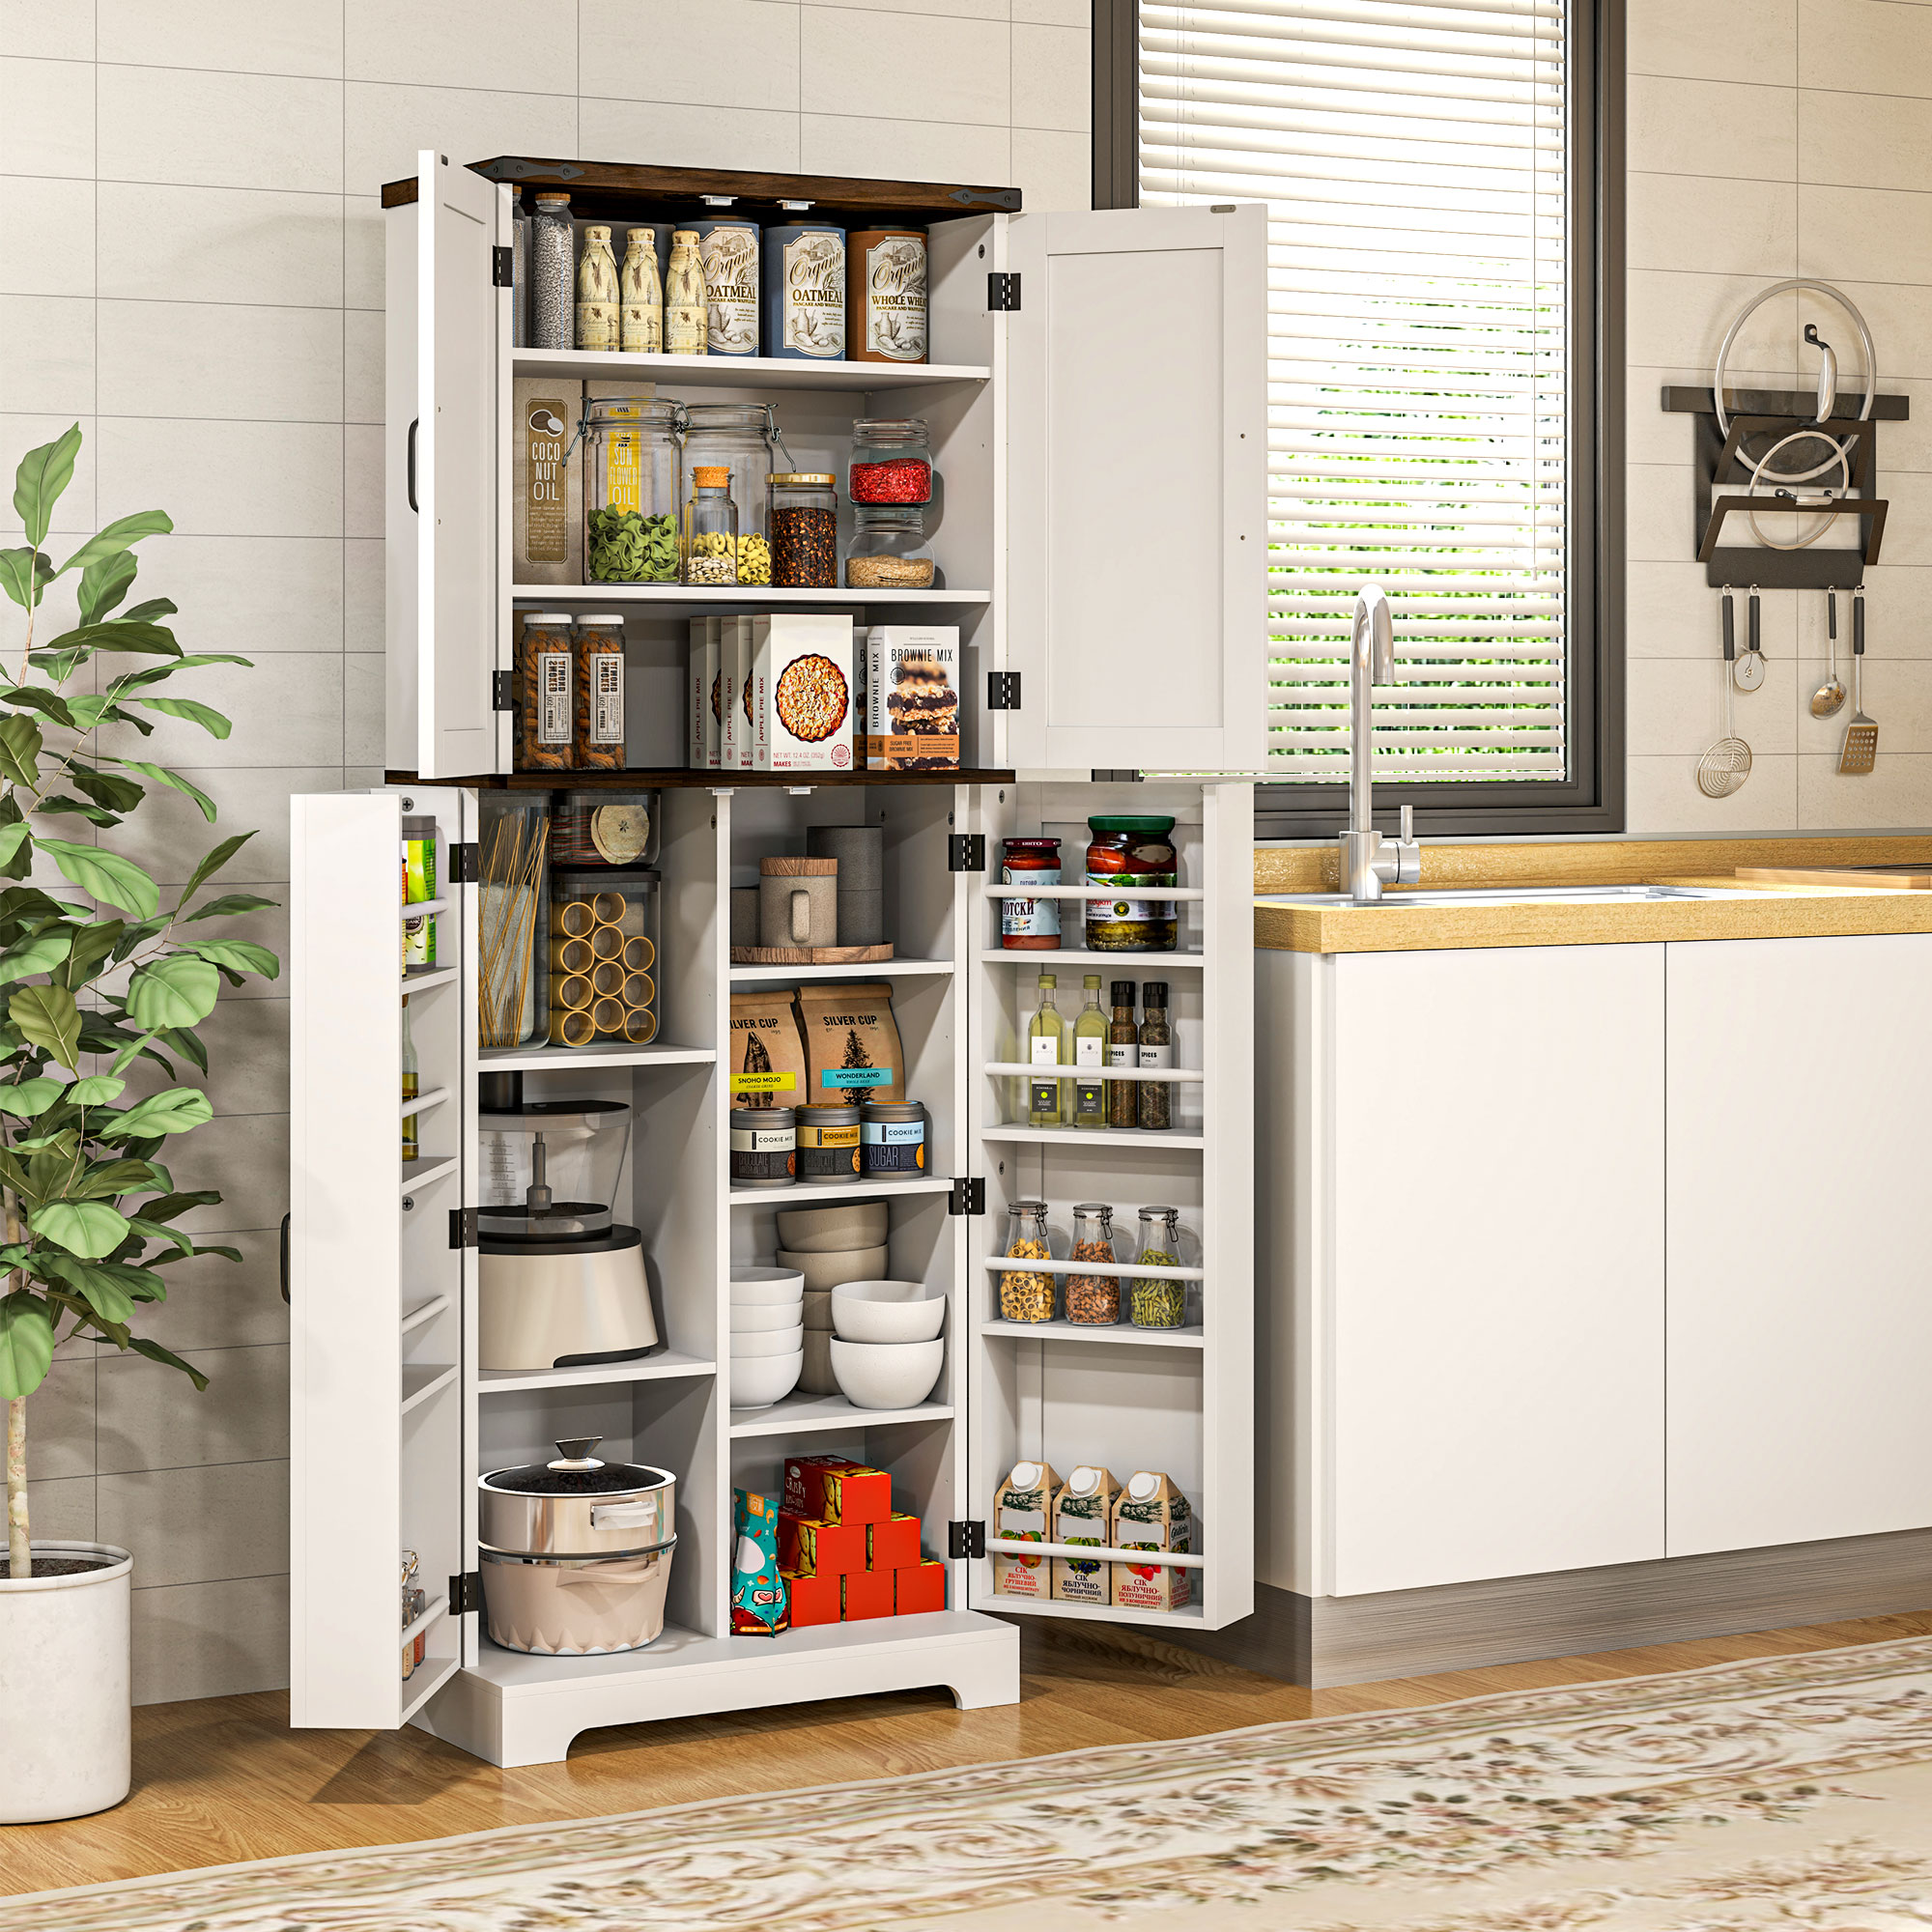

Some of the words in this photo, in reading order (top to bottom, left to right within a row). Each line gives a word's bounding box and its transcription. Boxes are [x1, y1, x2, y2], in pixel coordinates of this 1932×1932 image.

[706, 285, 756, 299] OATMEAL
[792, 289, 843, 303] OATMEAL
[871, 295, 906, 305] WHOLE
[531, 441, 560, 462] COCO
[613, 447, 633, 466] SUN
[535, 462, 557, 481] NUT
[610, 467, 638, 486] FLOWER
[533, 481, 560, 501] OIL
[612, 486, 635, 505] OIL
[891, 648, 932, 663] BROWNIE
[936, 648, 953, 663] MIX
[729, 1019, 757, 1030] ILVER
[758, 1017, 779, 1029] CUP
[822, 1015, 857, 1026] SILVER
[857, 1015, 877, 1026] CUP
[869, 1146, 898, 1167] SUGAR
